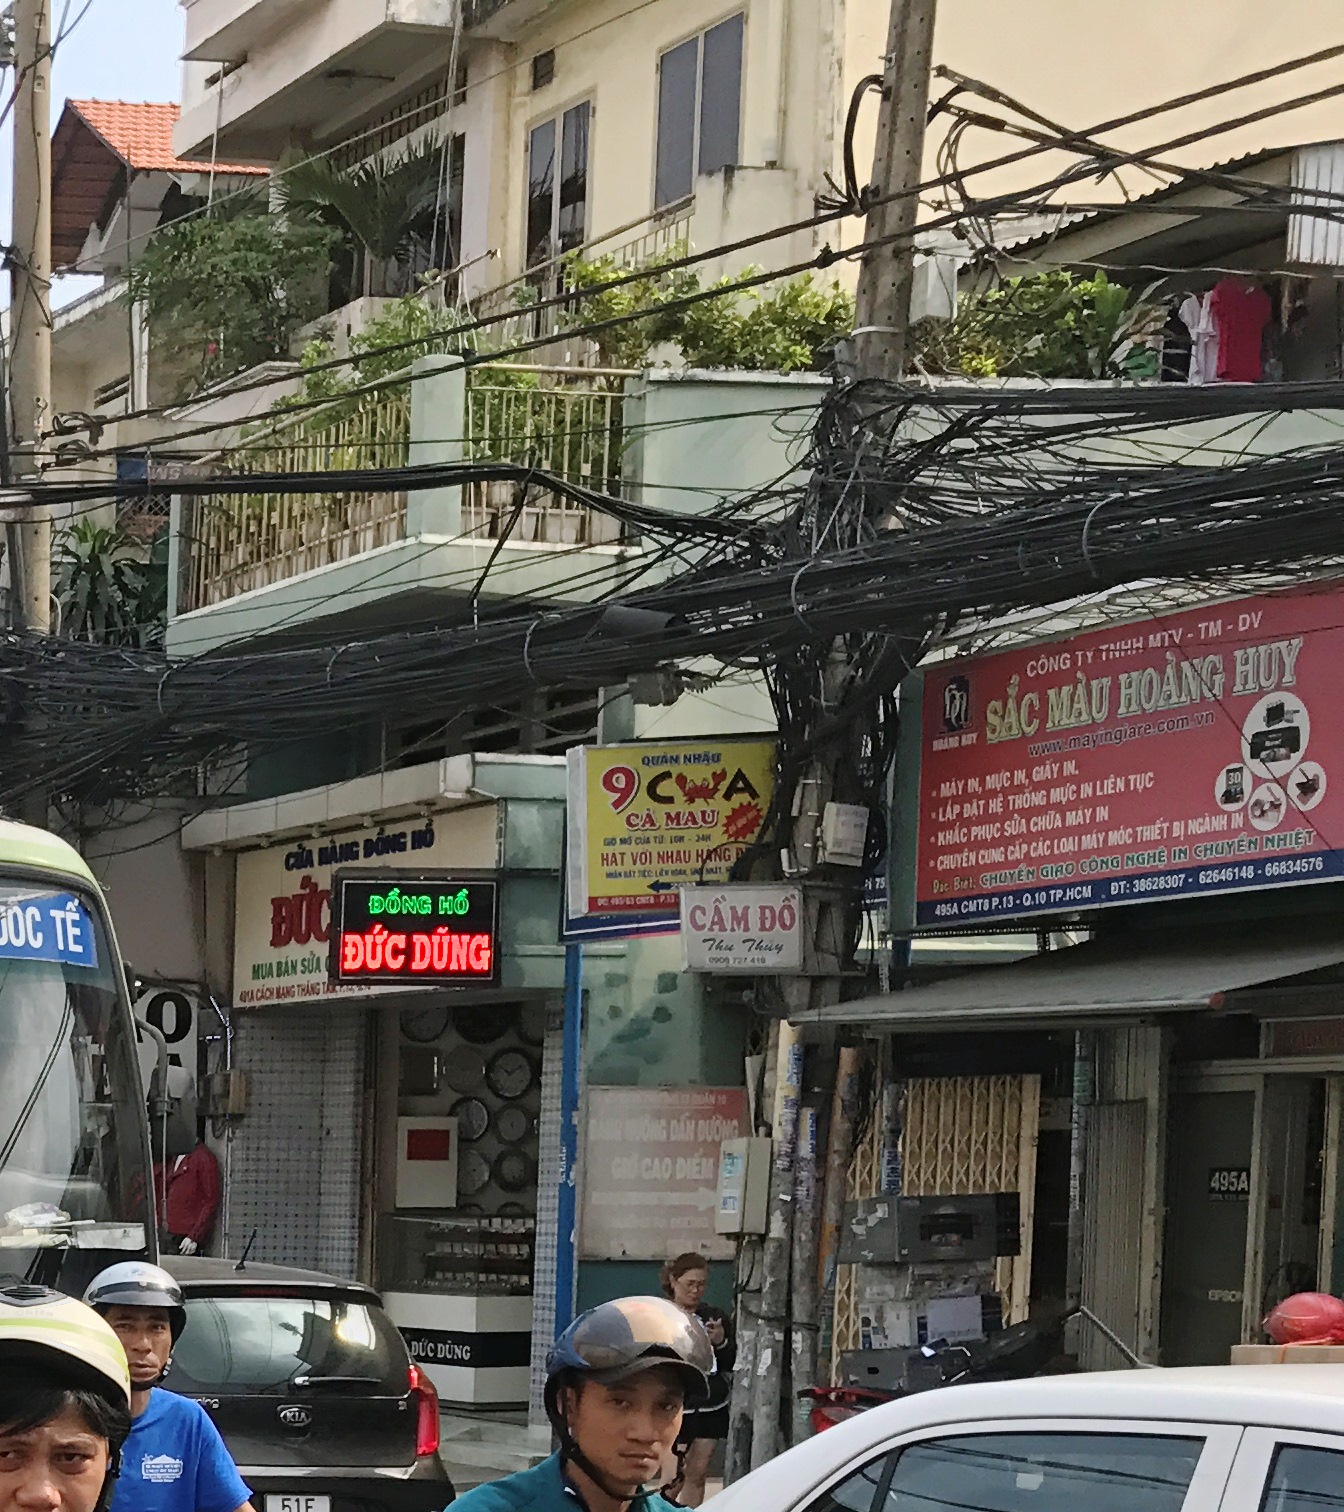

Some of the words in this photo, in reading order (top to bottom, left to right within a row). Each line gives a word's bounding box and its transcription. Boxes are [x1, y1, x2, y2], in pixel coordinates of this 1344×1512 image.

[1026, 654, 1071, 677] CÔNG
[1075, 649, 1094, 667] TY
[1099, 637, 1145, 661] TNHH
[1148, 628, 1183, 647] MTV
[1198, 619, 1222, 639] TM
[1238, 610, 1263, 632] DV
[1046, 671, 1111, 732] MÀU
[1117, 650, 1225, 718] HOÀNG
[1232, 636, 1303, 695] HUY
[602, 766, 640, 814] 9
[940, 778, 963, 798] MÁY
[985, 770, 1011, 791] MỰC
[988, 793, 1003, 814] HỆ
[1008, 785, 1047, 811] THỐNG
[1050, 782, 1076, 804] MỰC
[1080, 782, 1093, 799] IN
[1096, 775, 1125, 797] LIÊN
[1129, 772, 1155, 793] TỤC
[664, 809, 719, 830] MAU
[971, 821, 1001, 845] PHỤC
[1065, 805, 1092, 827] MÁY
[1096, 806, 1109, 822] IN
[1054, 836, 1078, 856] LOẠI
[1081, 830, 1104, 851] MÁY
[1136, 817, 1169, 843] THIẾT
[1187, 813, 1228, 836] NGÀNH
[1231, 812, 1244, 828] IN
[657, 849, 691, 865] NHAU
[1039, 861, 1075, 880] GIAO
[1079, 855, 1121, 875] CÔNG
[1124, 846, 1167, 869] NGHỆ
[1172, 847, 1188, 862] IN
[1264, 827, 1316, 852] NHIỆT
[369, 888, 431, 914] ĐỒNG
[438, 888, 469, 914] HỒ
[935, 902, 959, 917] 495A
[991, 895, 1013, 910] P.13
[1050, 885, 1092, 901] TP.HCM
[1110, 881, 1131, 896] ĐT:
[1198, 865, 1254, 884] 62646148
[1265, 857, 1323, 876] 66834576
[50, 898, 83, 953] TẾ
[689, 894, 750, 933] CẦM
[758, 894, 797, 932] ĐỒ
[343, 922, 407, 971] ĐỨC
[412, 926, 491, 971] DŨNG
[702, 938, 735, 952] Thu
[252, 963, 274, 981] MUA
[276, 955, 298, 979] BÁN
[1211, 1170, 1248, 1192] 495A
[411, 1338, 434, 1357] ĐỨC
[286, 1411, 308, 1422] KIA
